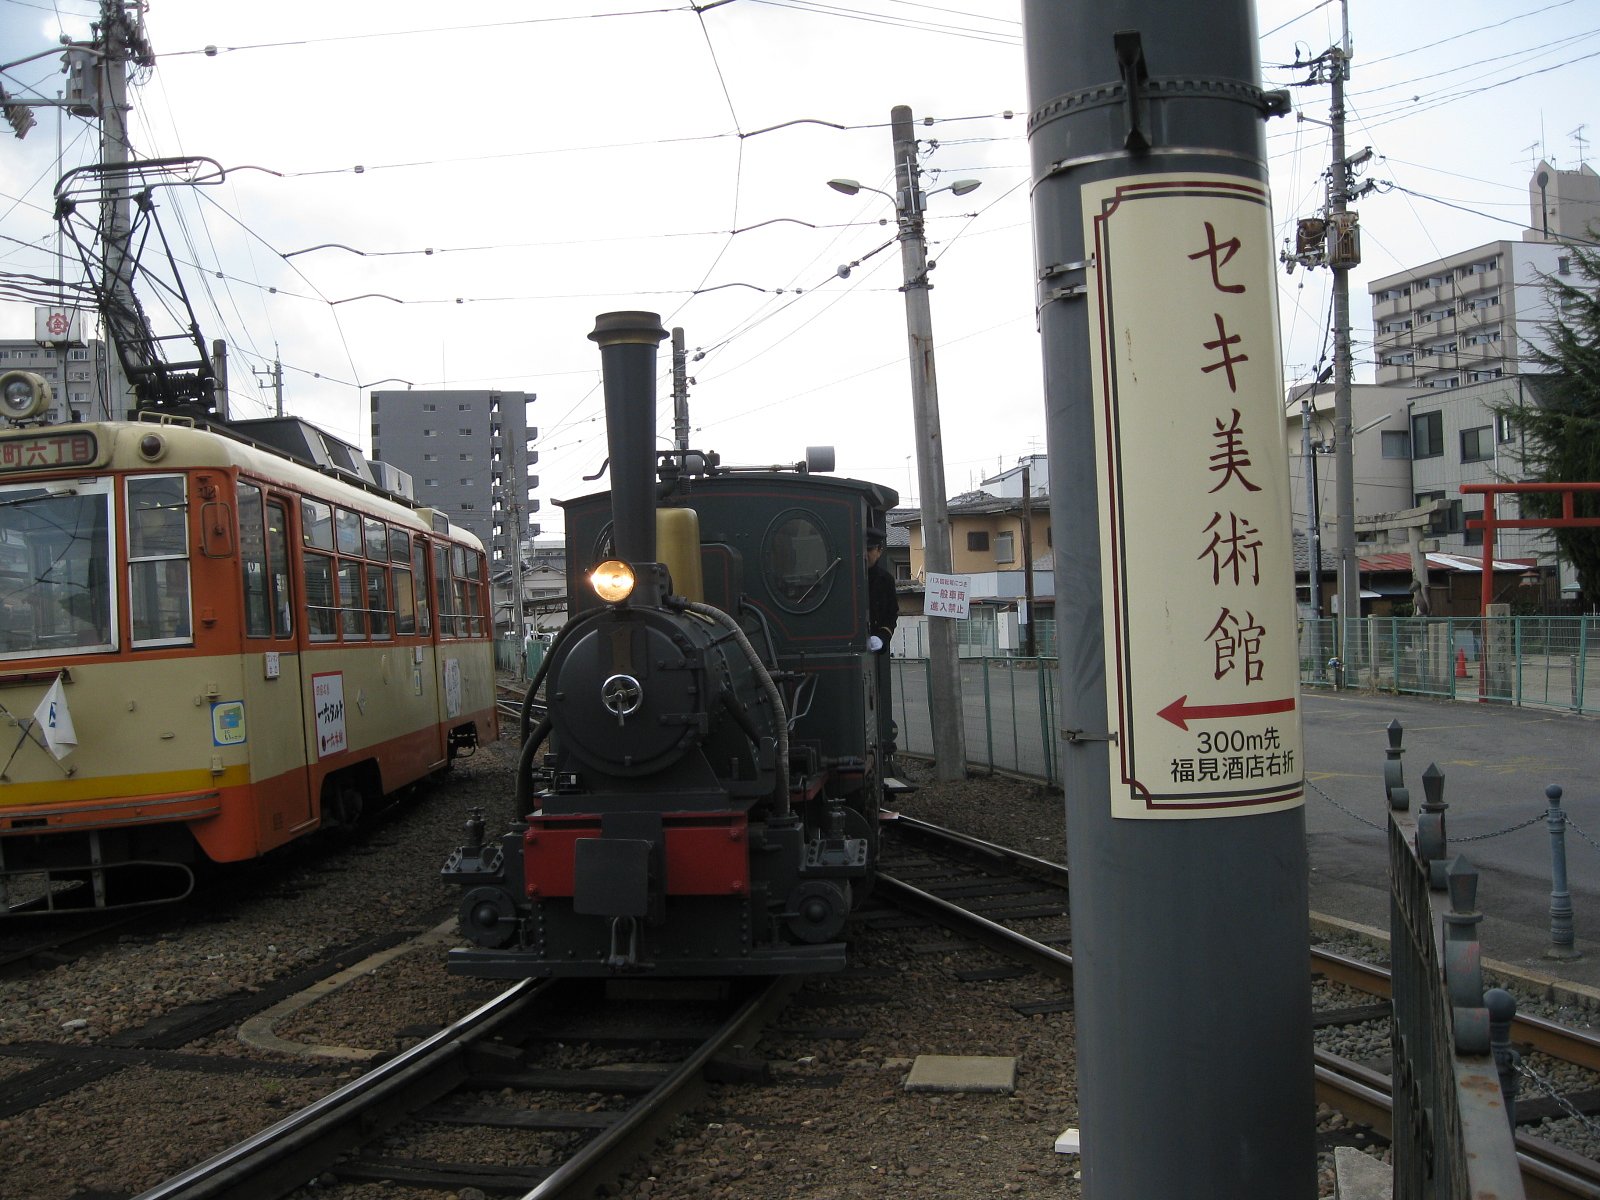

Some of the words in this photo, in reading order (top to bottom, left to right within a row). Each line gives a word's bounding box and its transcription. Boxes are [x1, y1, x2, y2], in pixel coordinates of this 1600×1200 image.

[0, 438, 89, 467] 町六丁目
[1187, 221, 1266, 687] セキ美術館
[930, 601, 964, 615] 進入禁止
[931, 588, 966, 602] 一般車両
[1197, 726, 1281, 754] 300m先
[1170, 749, 1295, 783] 福見酒店右折
